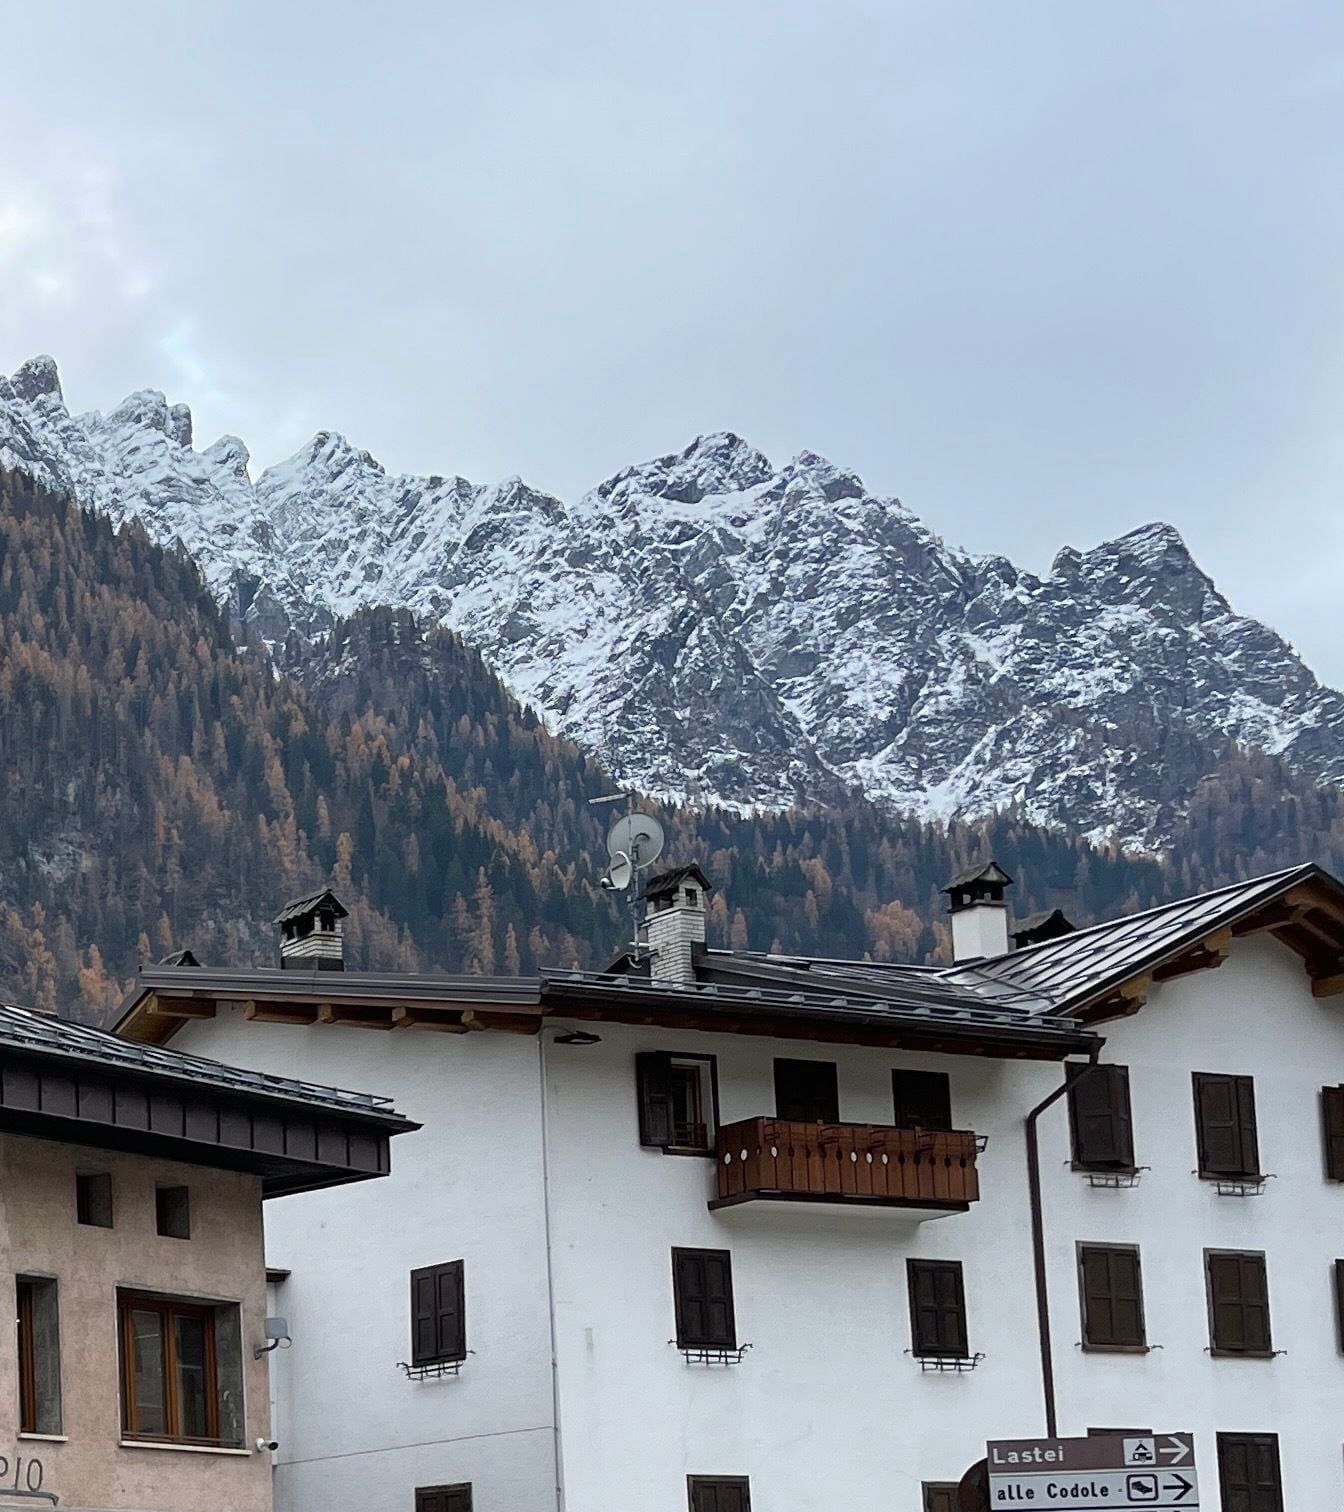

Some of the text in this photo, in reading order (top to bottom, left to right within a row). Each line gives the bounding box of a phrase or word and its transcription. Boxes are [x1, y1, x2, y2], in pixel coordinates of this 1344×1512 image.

[993, 1446, 1064, 1464] Lastei
[997, 1482, 1109, 1500] alle Codole
